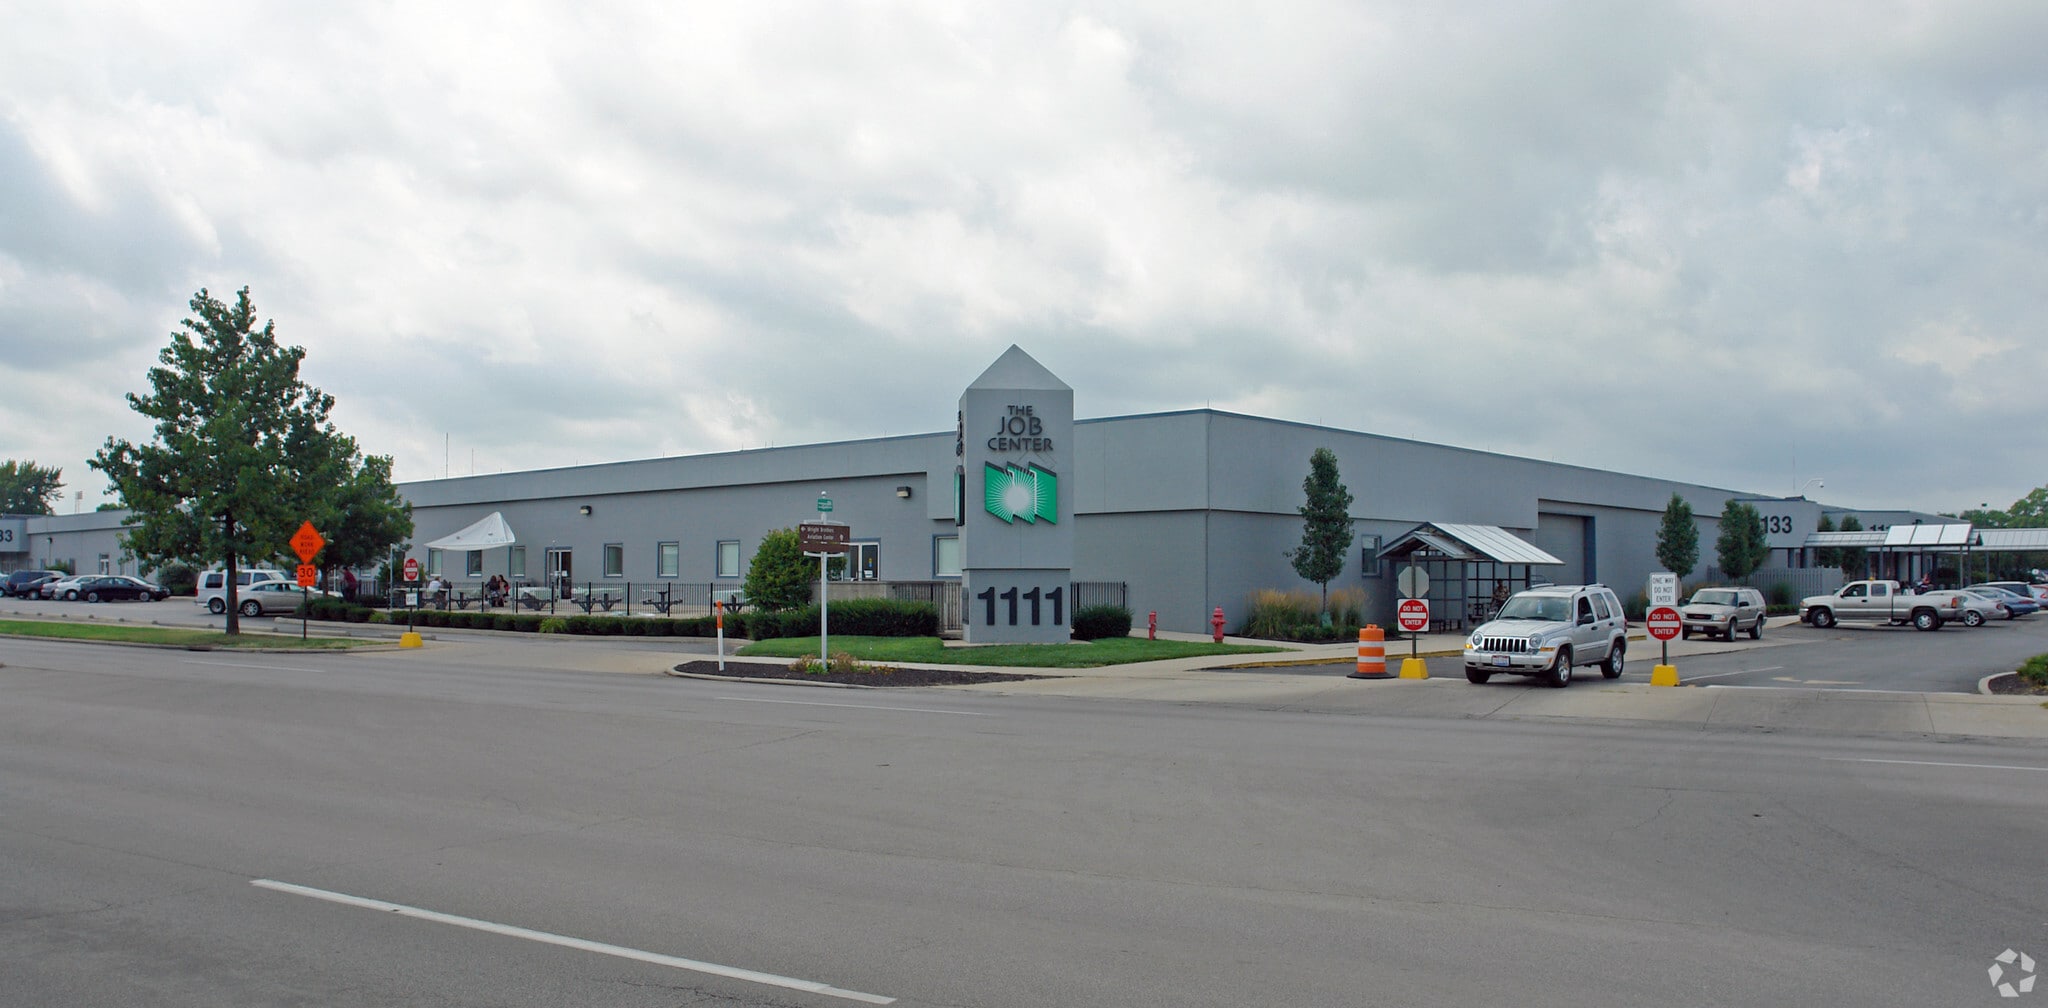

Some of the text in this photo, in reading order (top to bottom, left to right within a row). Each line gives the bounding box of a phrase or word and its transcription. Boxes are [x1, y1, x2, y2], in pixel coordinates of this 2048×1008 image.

[1007, 405, 1034, 416] THE
[997, 416, 1043, 436] JOB
[987, 437, 1054, 452] CENTER
[299, 567, 313, 577] 30
[977, 586, 1063, 626] 1111
